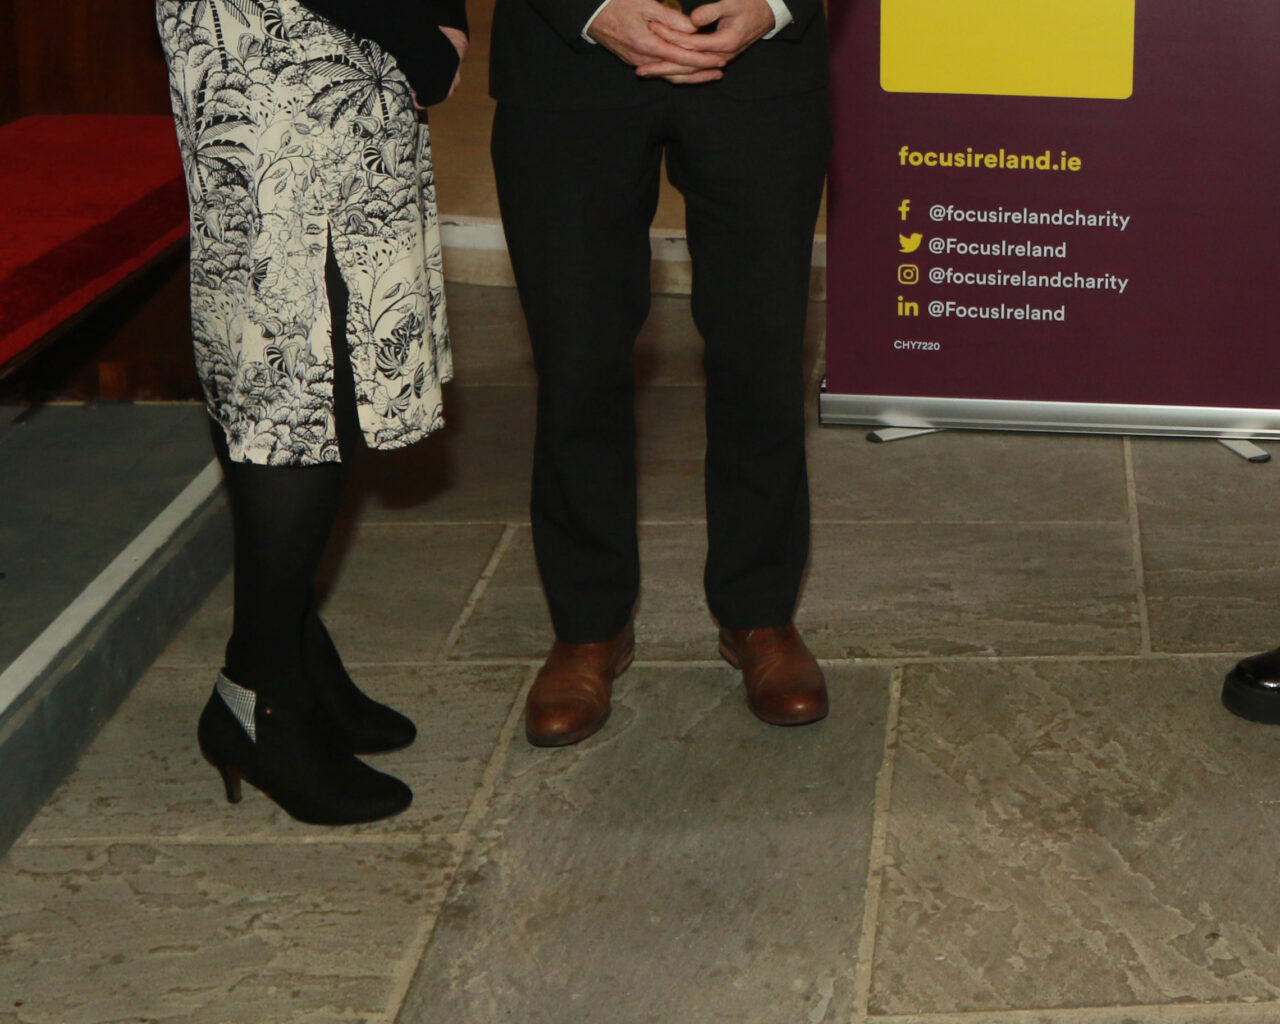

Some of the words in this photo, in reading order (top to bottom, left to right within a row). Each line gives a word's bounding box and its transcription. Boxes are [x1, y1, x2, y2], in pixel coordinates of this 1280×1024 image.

[898, 145, 1082, 172] focusireland.ie
[929, 204, 1131, 232] @focusirelandcharity
[928, 237, 1067, 259] @FocusIreland
[928, 266, 1129, 294] @focusirelandcharity
[927, 300, 1066, 322] @FocusIreland
[893, 339, 941, 351] CHY7220
